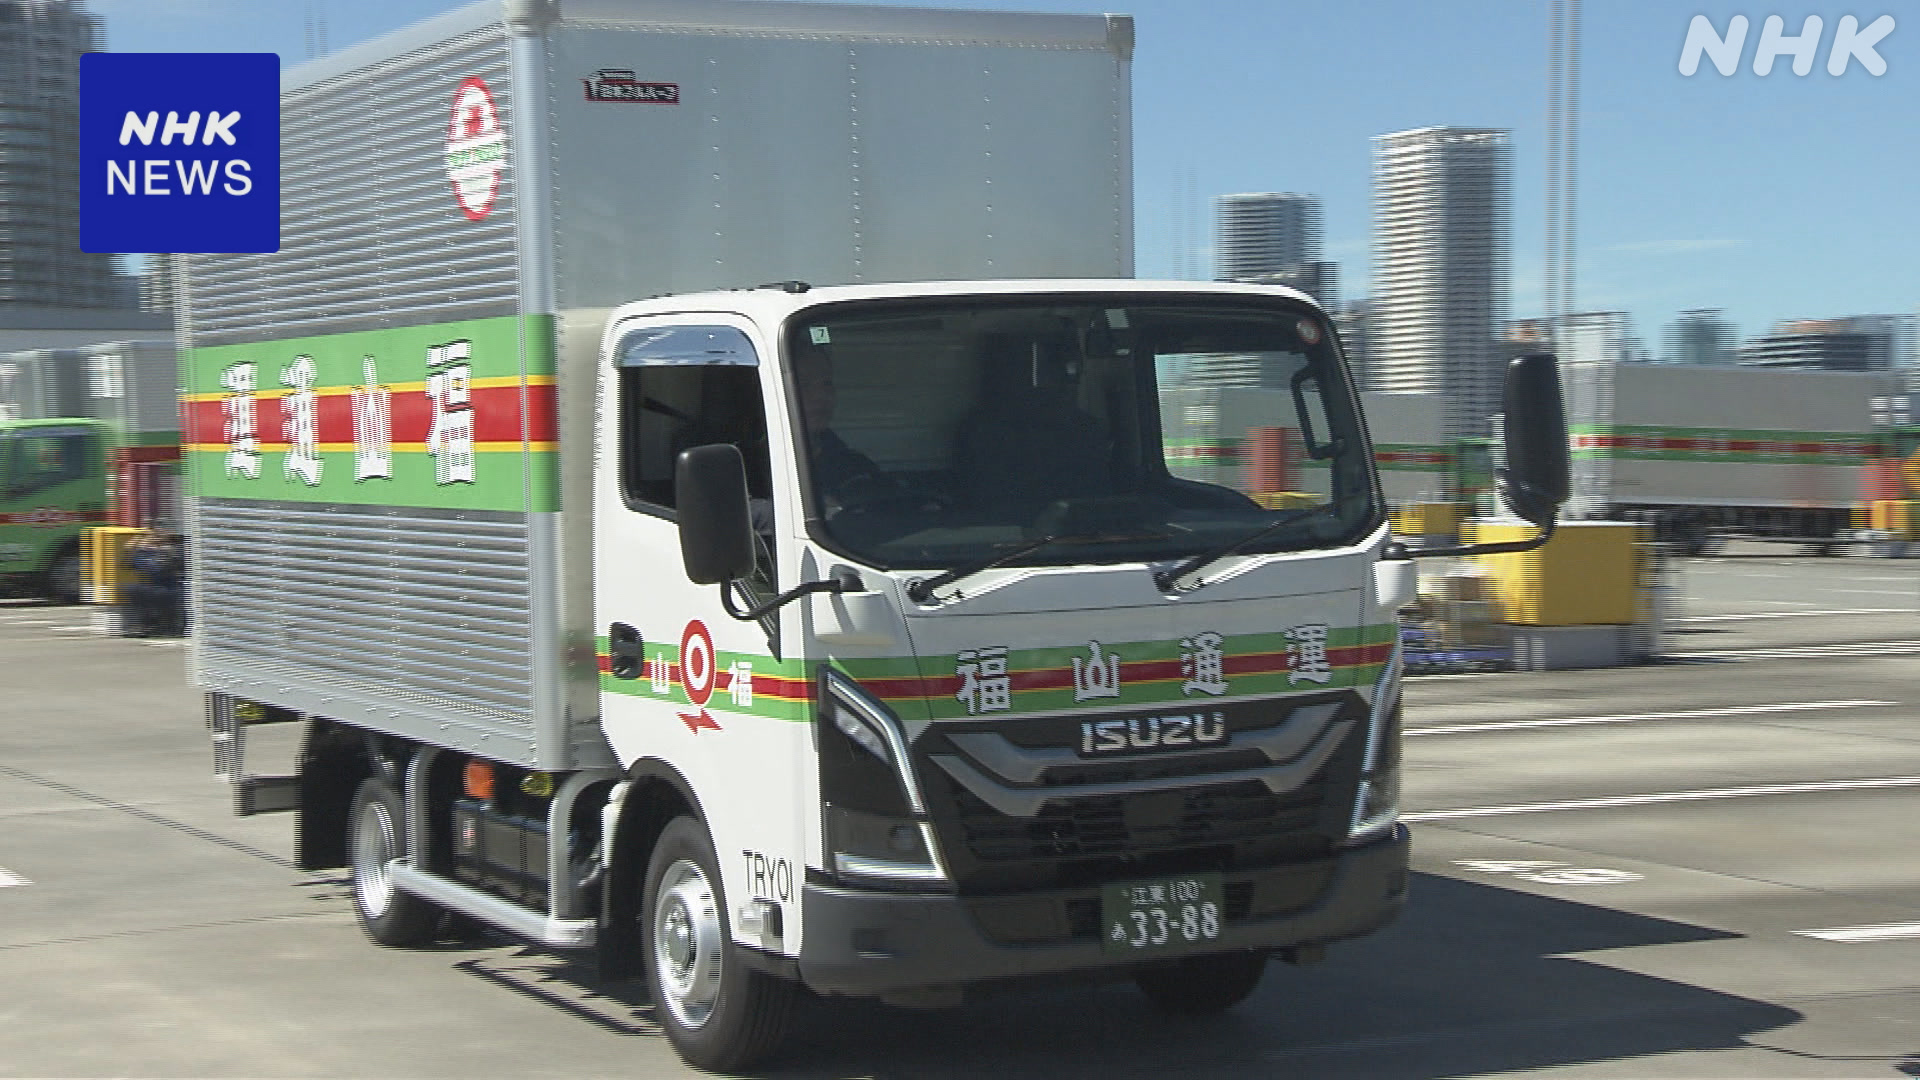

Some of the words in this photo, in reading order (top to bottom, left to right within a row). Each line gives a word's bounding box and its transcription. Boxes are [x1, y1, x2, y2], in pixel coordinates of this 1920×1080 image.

[955, 622, 1334, 716] 福山通運
[1081, 711, 1226, 754] ISUZU
[1169, 879, 1200, 903] 100
[1110, 921, 1128, 941] あ
[1128, 901, 1220, 948] 33-88
